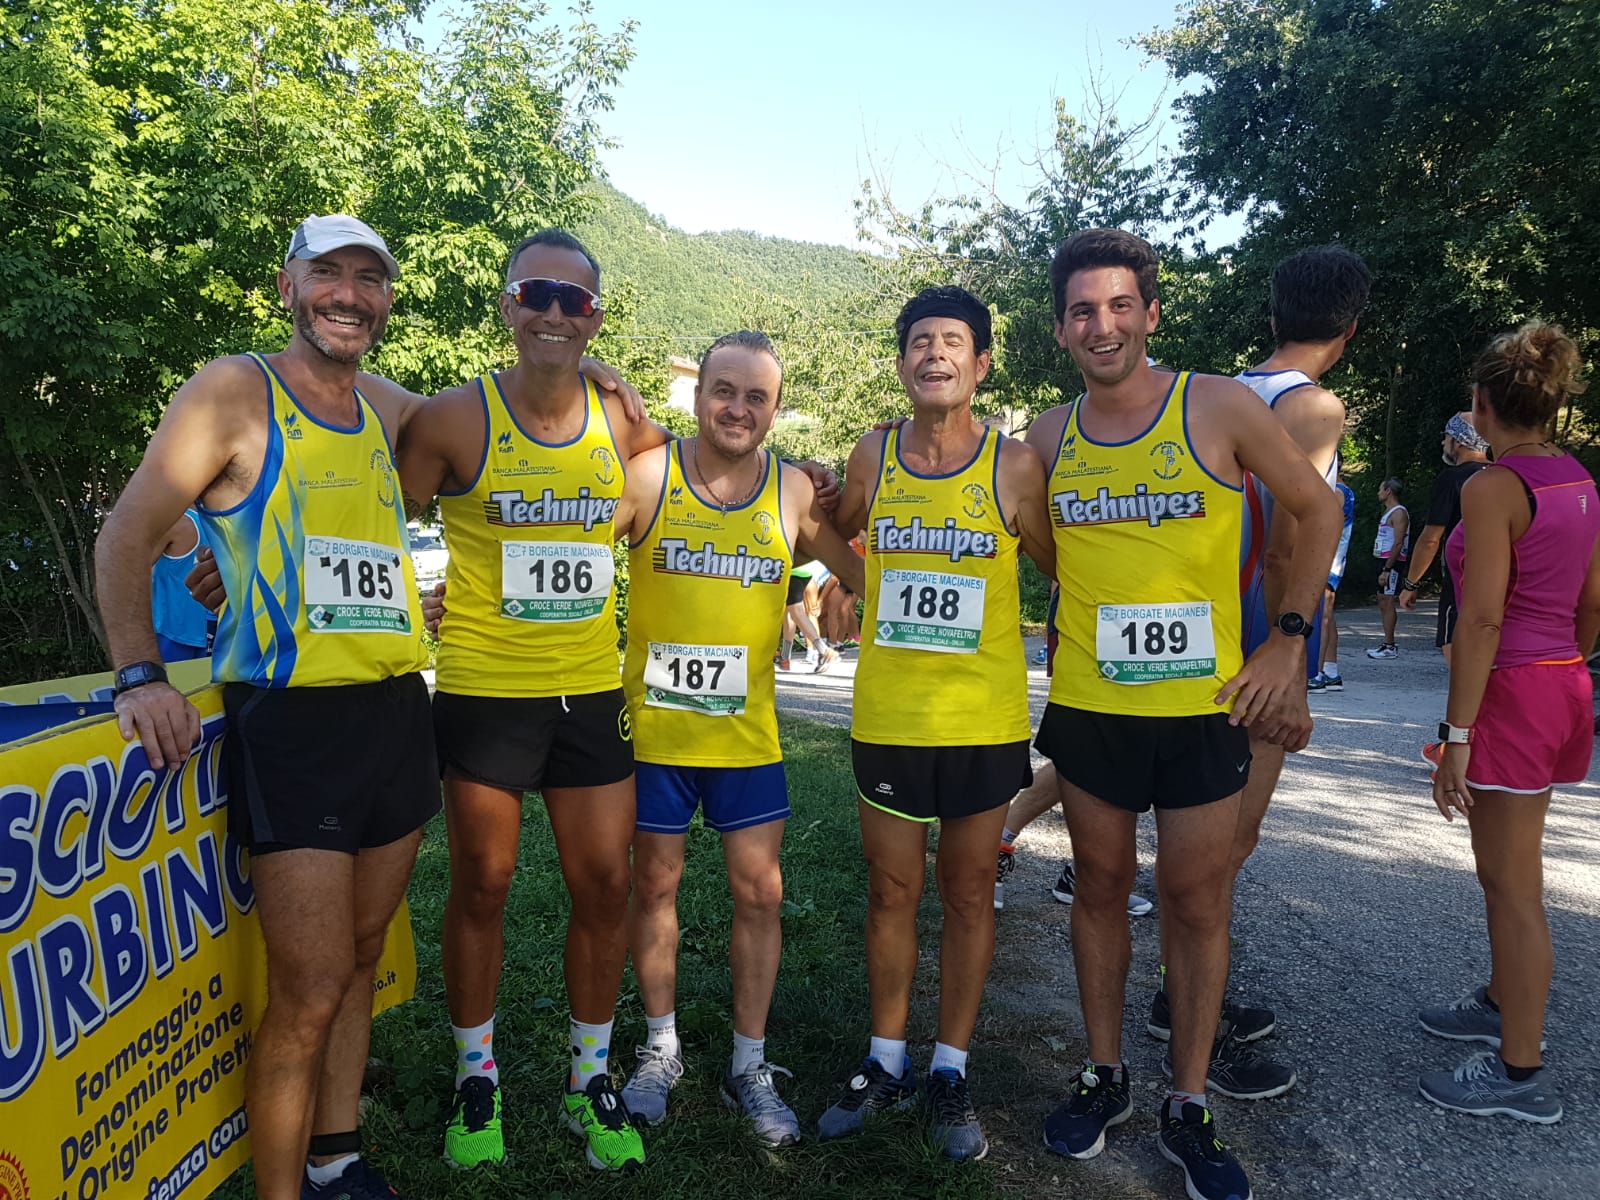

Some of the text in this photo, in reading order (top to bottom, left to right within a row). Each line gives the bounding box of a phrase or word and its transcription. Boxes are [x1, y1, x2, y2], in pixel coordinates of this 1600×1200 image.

[1052, 483, 1201, 527] Technipes
[332, 542, 370, 558] BORGATE
[529, 545, 569, 557] BORGATE
[875, 515, 997, 562] Technipes
[333, 558, 393, 601] 185
[529, 559, 593, 594] 186
[659, 538, 783, 588] Technipes
[901, 572, 937, 584] BORGATE
[940, 575, 983, 590] MACIANESI
[336, 606, 360, 617] CROCE
[362, 607, 382, 618] VERDE
[529, 601, 551, 610] CROCE
[553, 601, 572, 610] VERDE
[899, 584, 960, 621] 188
[1121, 608, 1163, 619] BORGATE
[1165, 606, 1208, 618] MACIANESI
[897, 623, 977, 640] CROCE VERDE NOVAFELTRIA
[1121, 620, 1188, 655] 189
[668, 644, 702, 657] BORGATE
[1123, 660, 1212, 672] CROCE VERDE NOVAFELTRIA
[668, 657, 726, 690] 187
[75, 972, 222, 1117] Formaggio a
[60, 1002, 243, 1182] Denominazione
[78, 1107, 169, 1200] Origine
